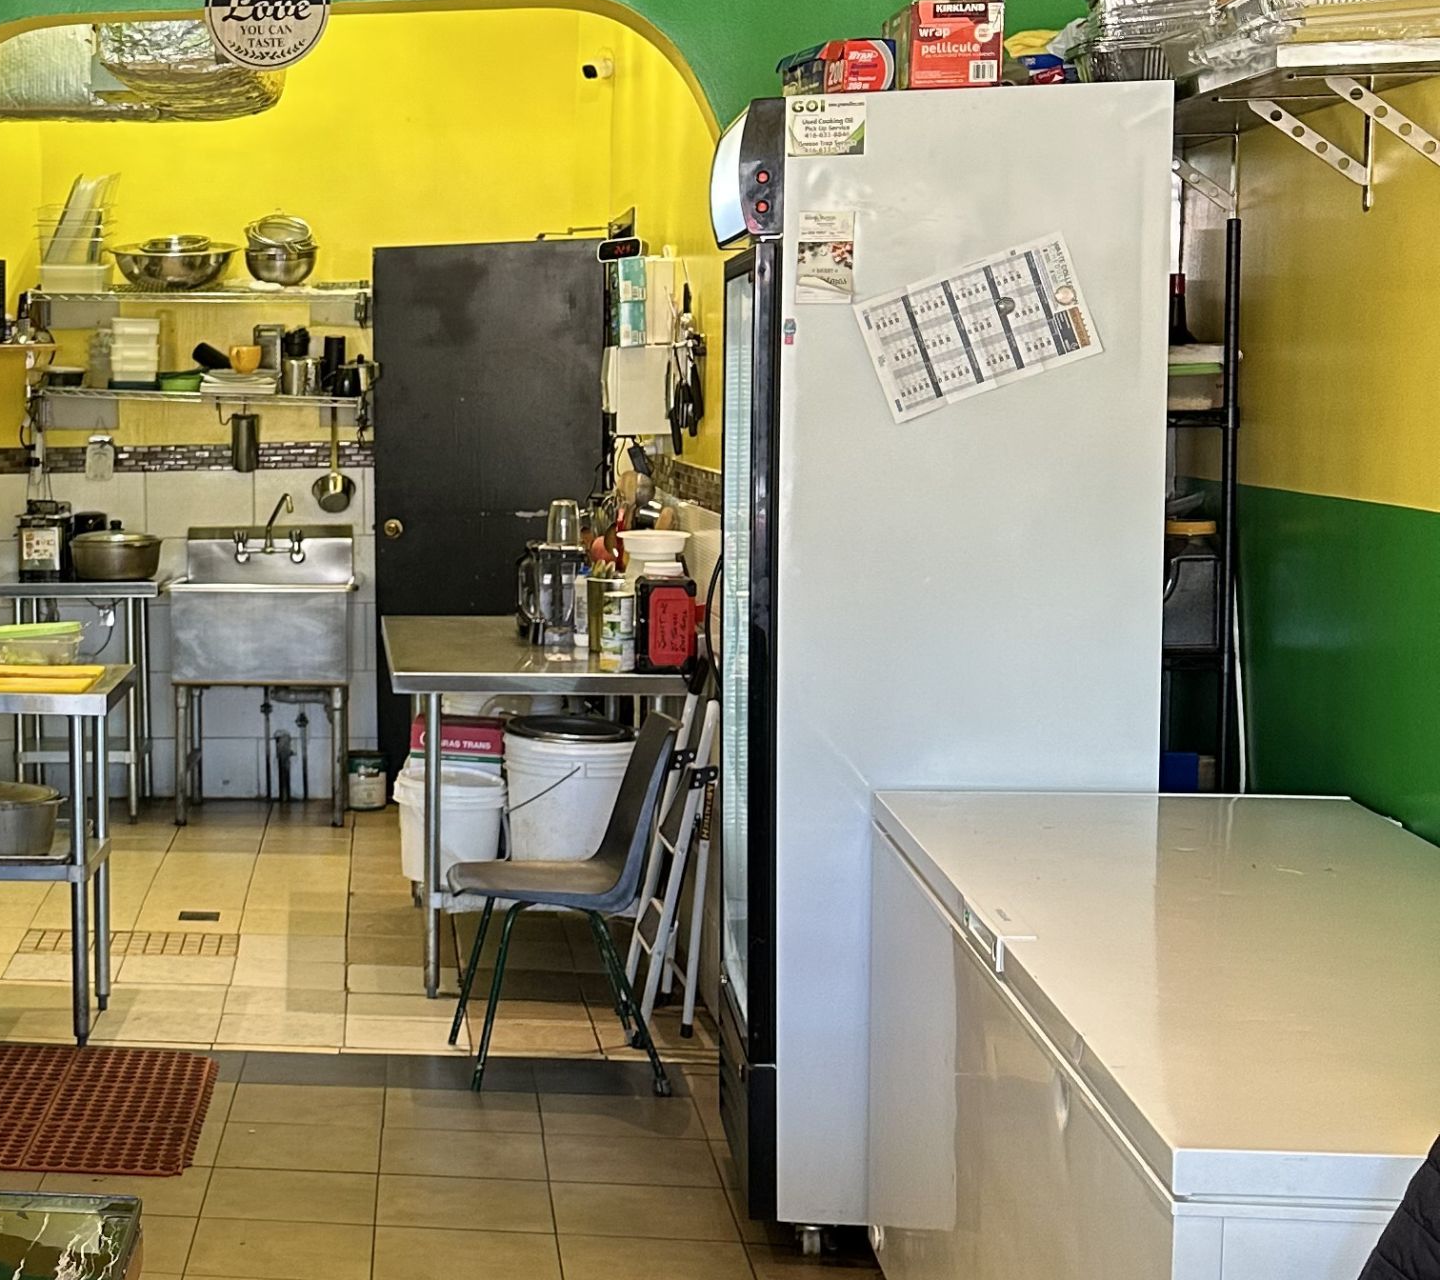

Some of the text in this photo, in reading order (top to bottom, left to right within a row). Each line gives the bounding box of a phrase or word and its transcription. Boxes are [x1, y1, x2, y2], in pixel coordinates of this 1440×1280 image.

[936, 3, 986, 12] KIRKLAND
[240, 24, 293, 35] YOU CAN
[919, 27, 950, 39] wrap
[248, 38, 285, 48] TASTE
[922, 42, 981, 56] pellicule
[463, 740, 491, 750] TRANS
